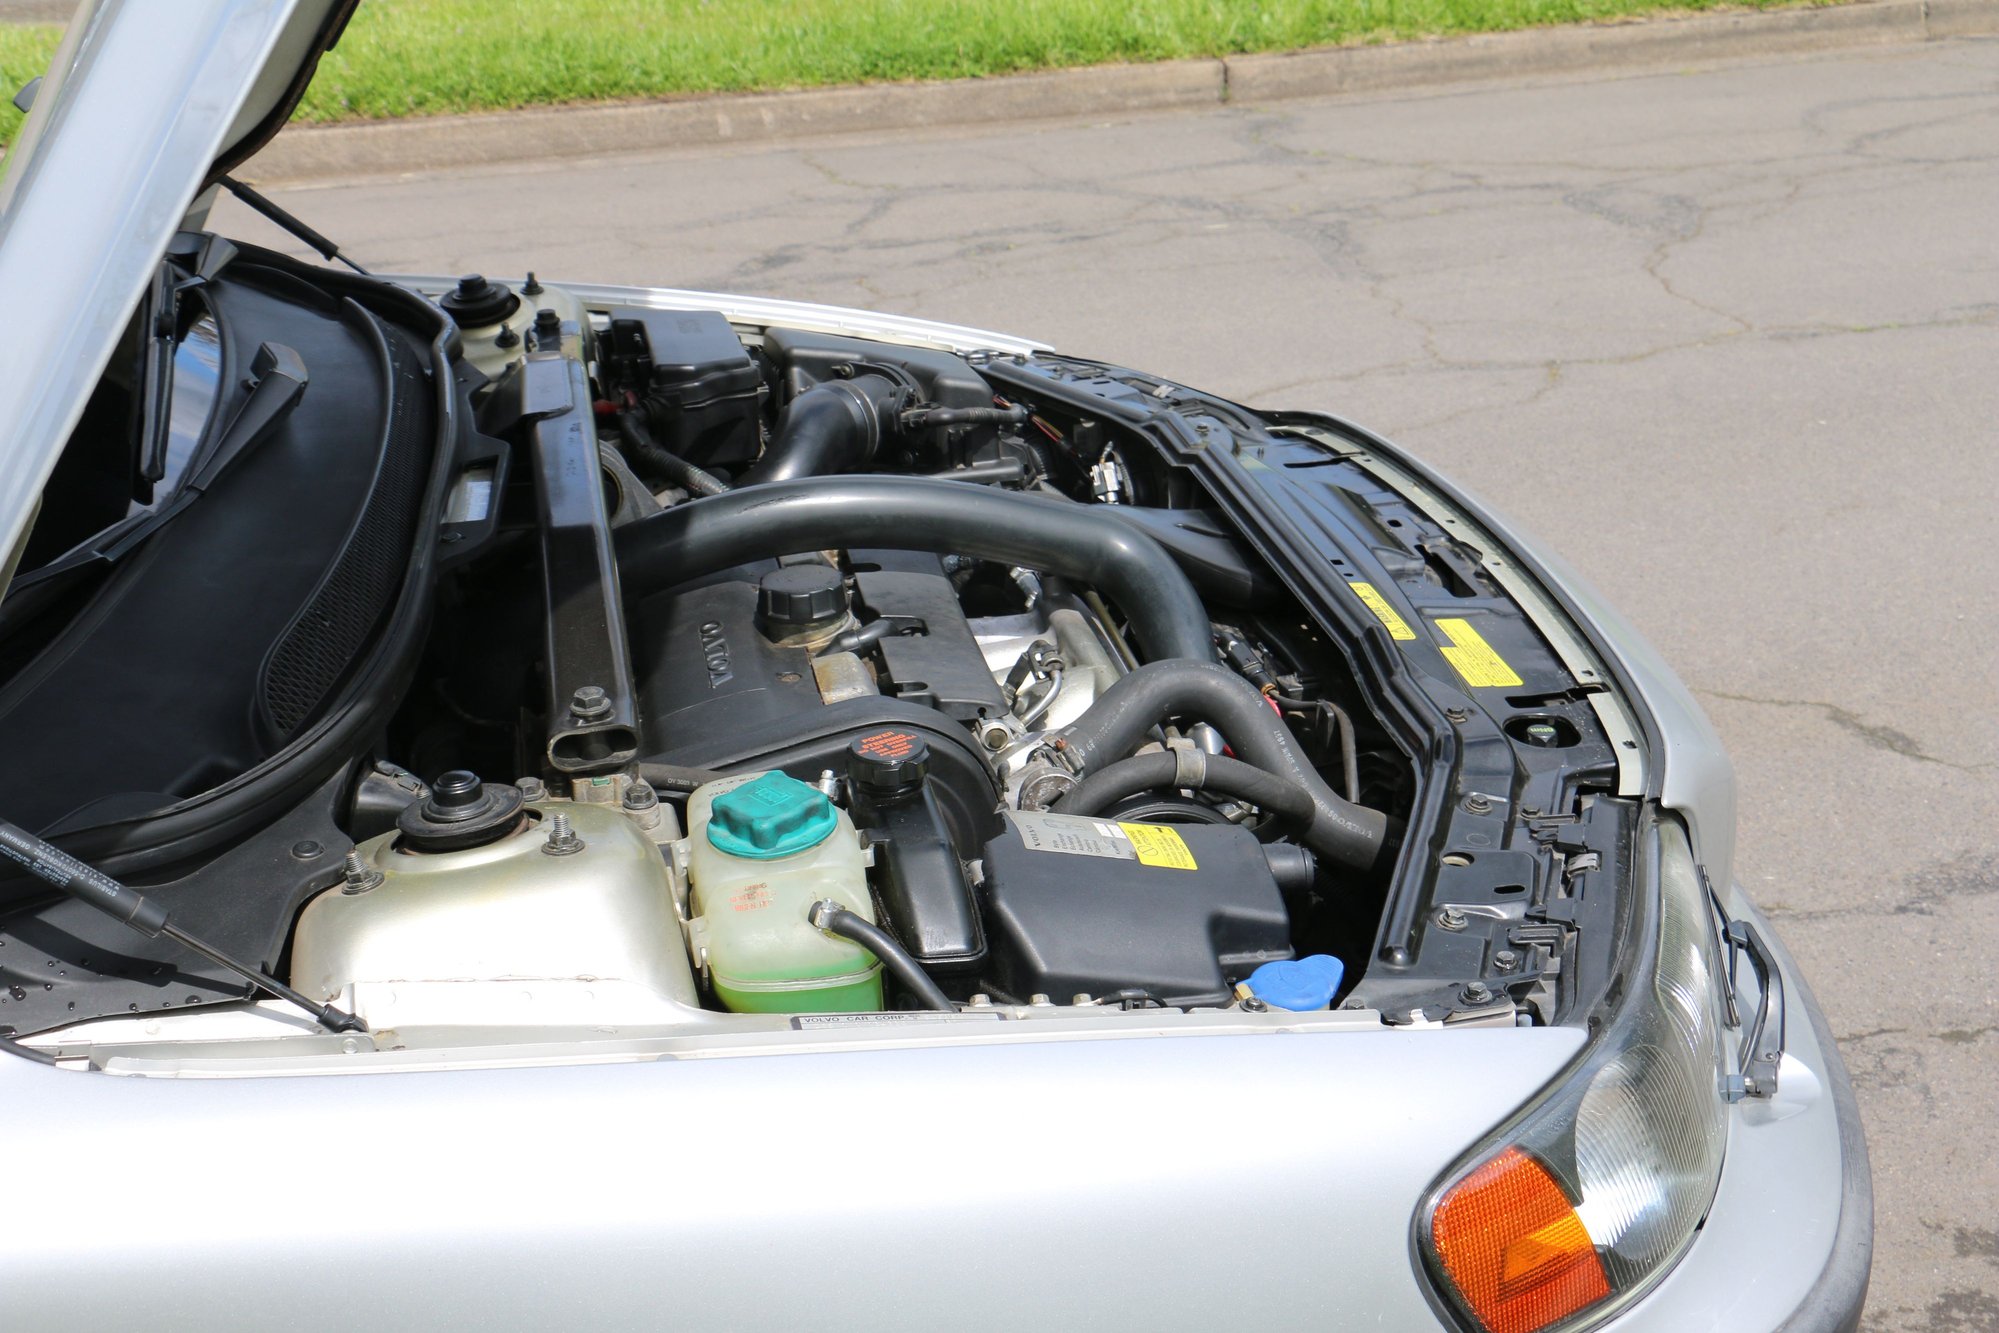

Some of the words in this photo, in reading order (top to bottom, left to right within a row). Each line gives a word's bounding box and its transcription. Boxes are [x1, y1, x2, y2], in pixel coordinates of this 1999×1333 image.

[701, 621, 734, 688] VOLVO
[0, 830, 31, 850] GERMANY
[1026, 824, 1041, 847] VOLVO
[88, 878, 118, 897] STABILUS
